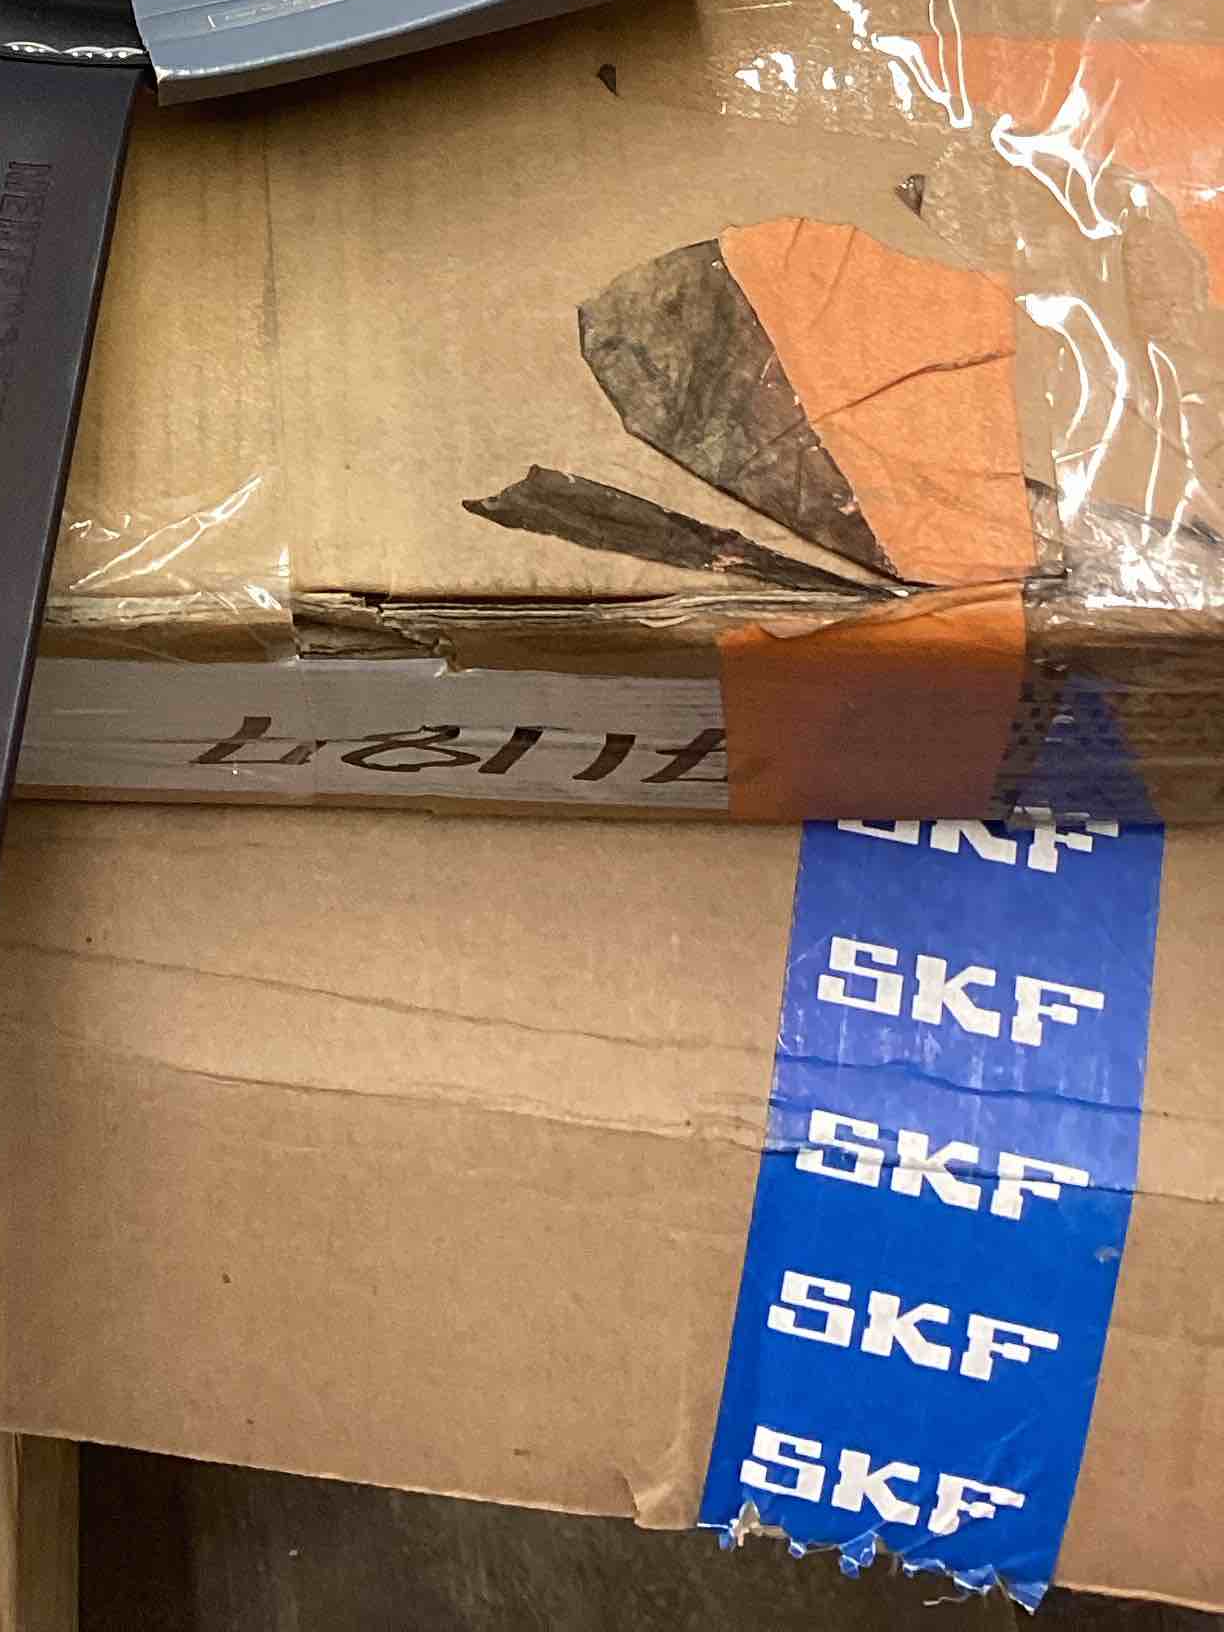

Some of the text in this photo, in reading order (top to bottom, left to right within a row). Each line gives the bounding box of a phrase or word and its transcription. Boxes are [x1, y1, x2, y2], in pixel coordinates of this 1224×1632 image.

[817, 935, 1104, 1047] SKF
[796, 1109, 1089, 1221] SKF
[767, 1270, 1059, 1382] SKF
[740, 1425, 1025, 1536] SKF
